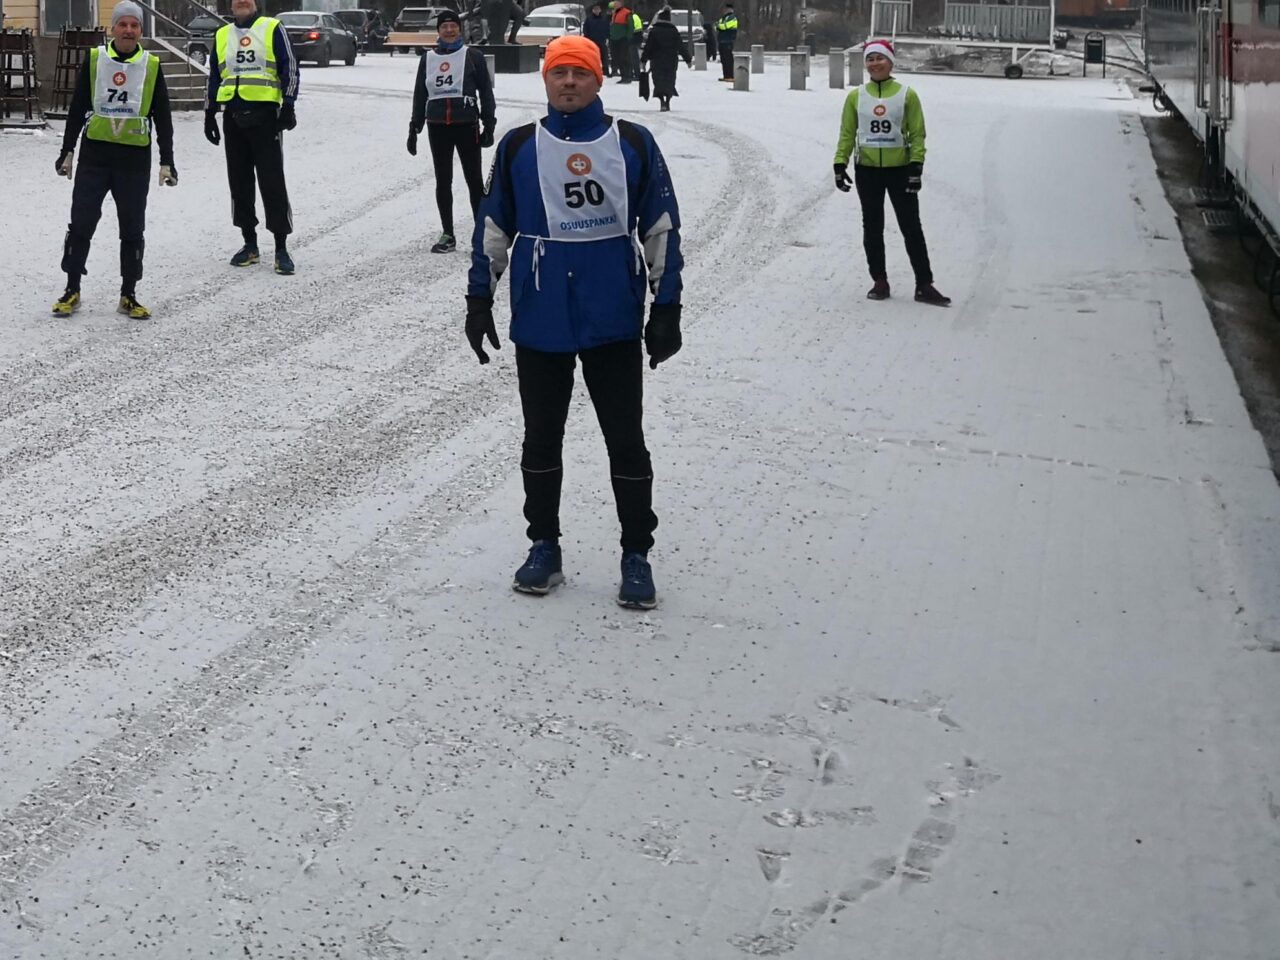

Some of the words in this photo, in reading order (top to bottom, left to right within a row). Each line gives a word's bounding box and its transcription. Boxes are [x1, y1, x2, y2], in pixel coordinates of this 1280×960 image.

[236, 50, 256, 63] 53
[435, 75, 453, 87] 54
[107, 88, 128, 103] 74
[870, 119, 891, 133] 89
[564, 179, 604, 208] 50
